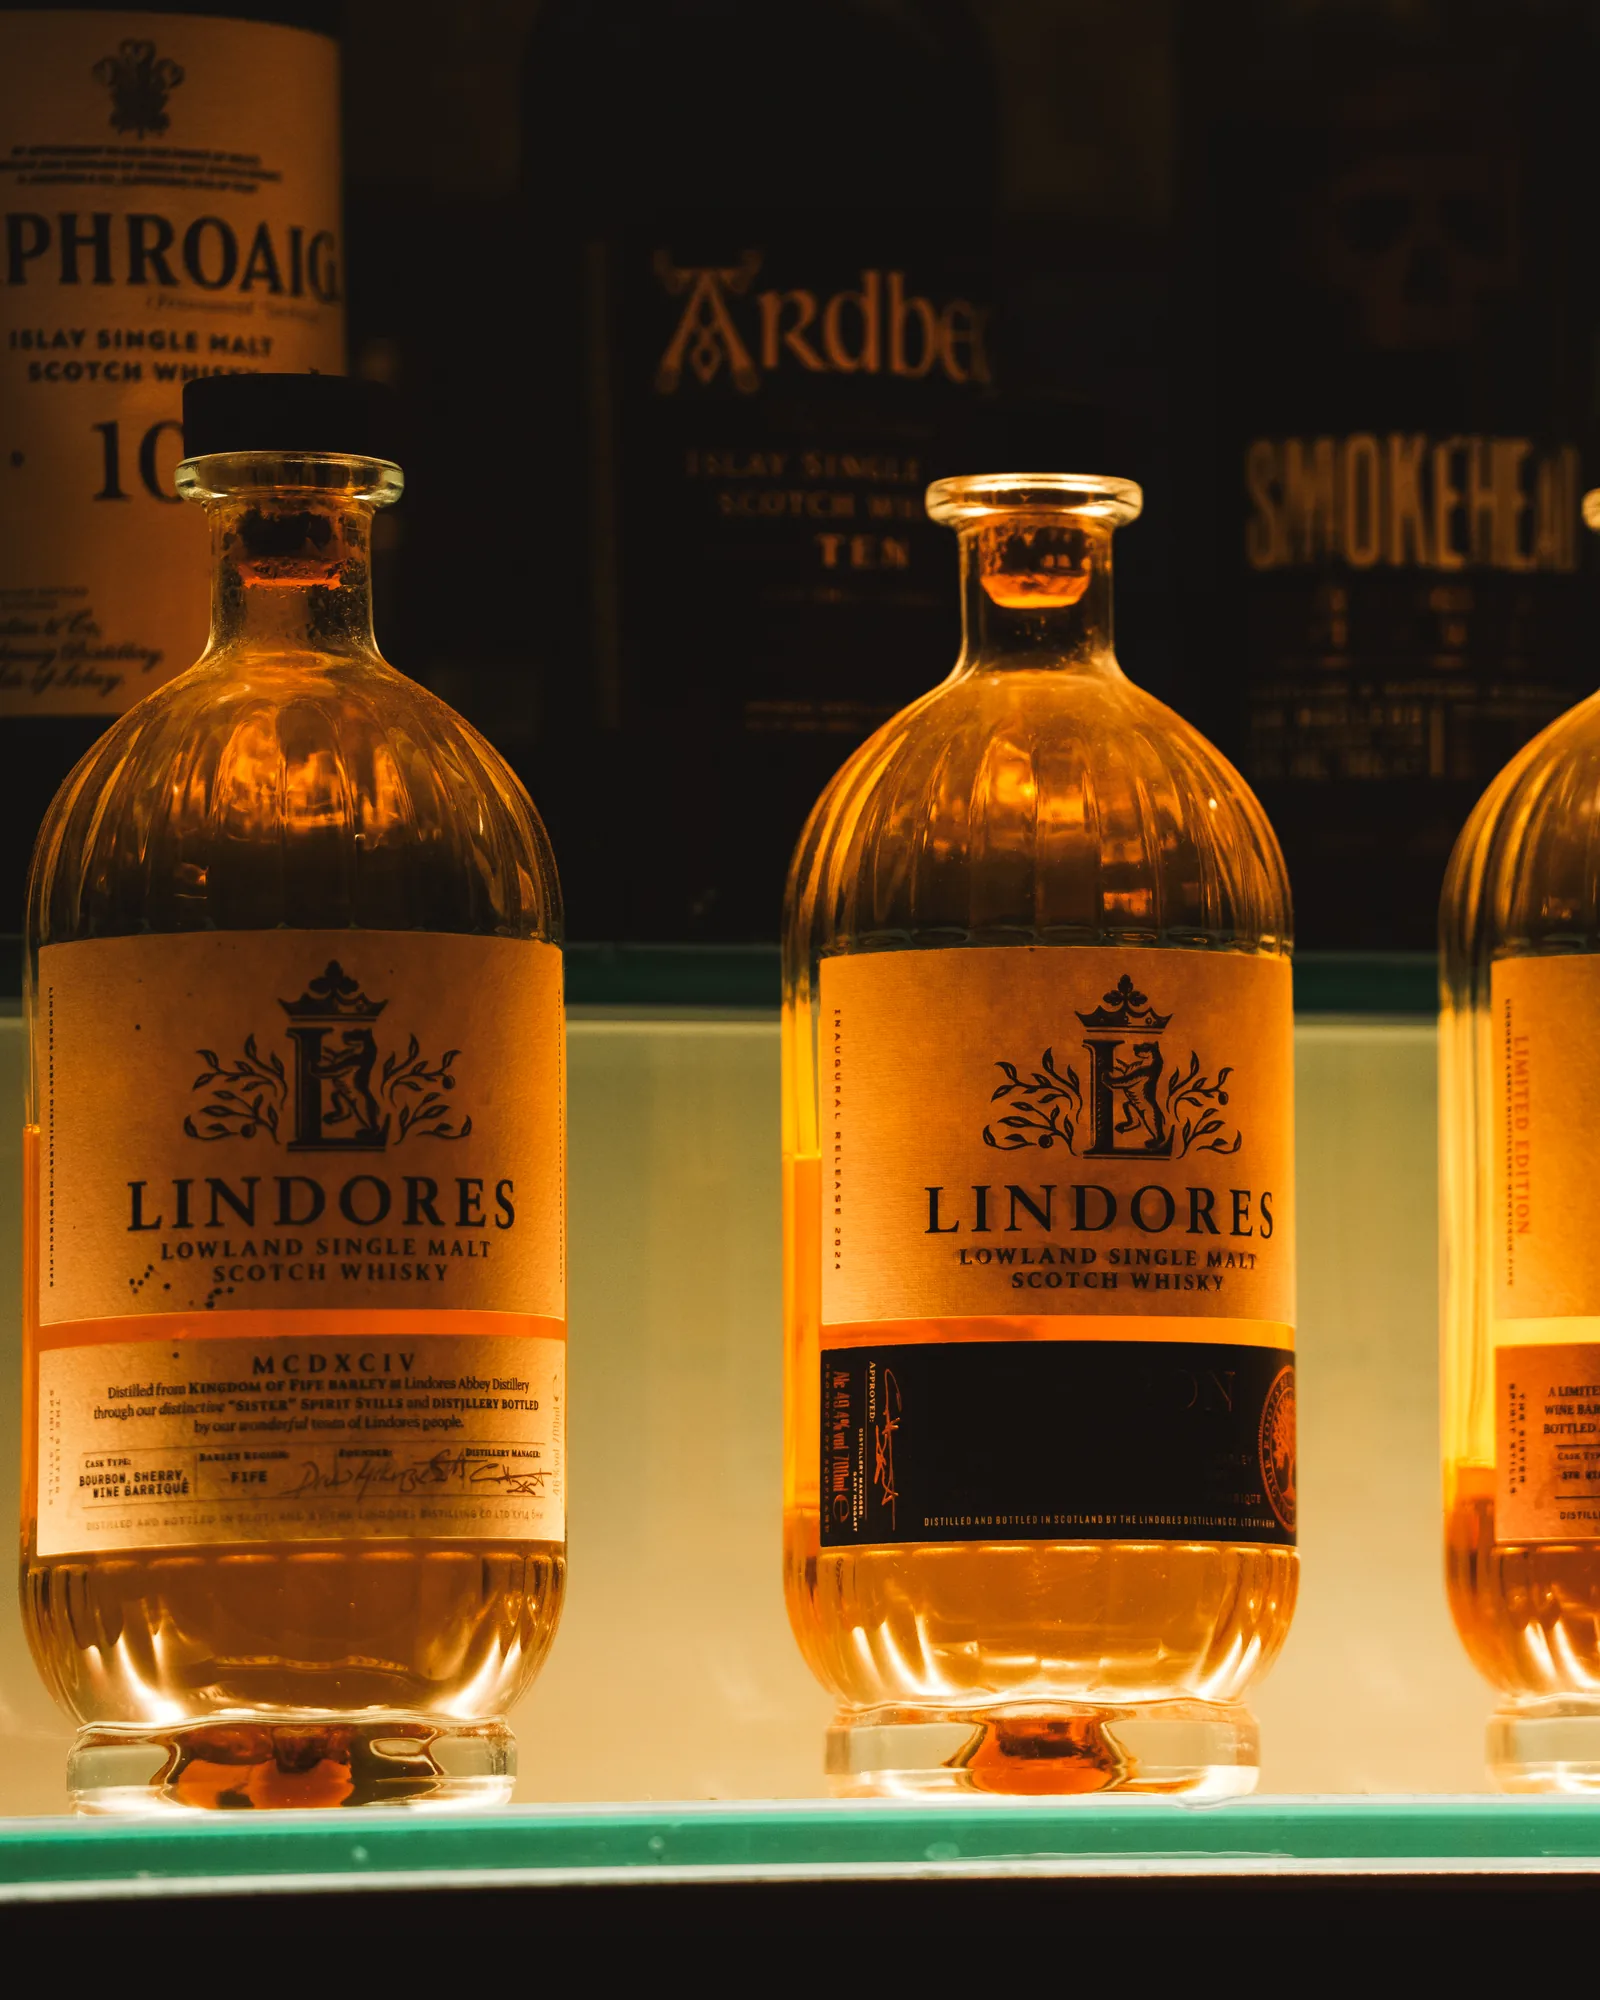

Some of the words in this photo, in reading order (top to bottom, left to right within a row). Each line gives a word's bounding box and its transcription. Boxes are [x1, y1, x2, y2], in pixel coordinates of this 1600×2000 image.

[8, 328, 86, 350] ISLAY
[96, 328, 199, 353] SINGLE
[207, 332, 275, 358] MALT
[27, 360, 144, 384] SCOTCH
[152, 361, 260, 383] WHIS
[91, 419, 185, 505] 10
[814, 532, 911, 570] TEN
[1514, 1036, 1529, 1131] LIMITED
[1515, 1140, 1531, 1235] EDITION
[127, 1174, 516, 1231] LINDORES
[925, 1184, 1274, 1239] LINDORES
[161, 1237, 304, 1261] LOWLAND
[317, 1237, 416, 1257] SINGLE
[428, 1238, 491, 1259] MALT
[959, 1247, 1098, 1266] LOWLAND
[1109, 1248, 1197, 1267] SINGLE
[1206, 1251, 1257, 1270] MALT
[212, 1263, 326, 1284] SCOTCH
[341, 1262, 449, 1282] WHISKY
[1012, 1271, 1118, 1289] SCOTCH
[1131, 1273, 1225, 1292] WHISKY
[252, 1352, 415, 1376] MCDXCIV
[108, 1384, 154, 1399] Distilled
[155, 1382, 186, 1397] from
[188, 1381, 261, 1394] KINGDOM
[289, 1379, 323, 1391] FIFE
[328, 1378, 387, 1390] BARLEY
[404, 1375, 457, 1390] Lindores
[458, 1376, 490, 1392] Abbey
[492, 1377, 530, 1393] Distillery
[833, 1370, 850, 1389] Alc
[1548, 1386, 1556, 1397] A
[868, 1361, 876, 1423] APPROVED:
[93, 1404, 135, 1421] through
[136, 1406, 157, 1416] our
[159, 1401, 225, 1416] distinctive
[355, 1397, 403, 1409] STILLS
[406, 1396, 430, 1409] and
[432, 1398, 498, 1411] DISTILLERY
[501, 1399, 539, 1411] BOTTLED
[1544, 1404, 1574, 1415] WINE
[194, 1418, 210, 1434] by
[213, 1420, 235, 1432] our
[239, 1416, 309, 1433] wonderful
[347, 1415, 361, 1429] of
[365, 1414, 421, 1430] Lindores
[422, 1415, 464, 1431] people.
[1543, 1423, 1596, 1434] BOTTLED
[231, 1470, 268, 1484] FIFE
[833, 1454, 850, 1492] 700ml
[92, 1485, 119, 1499] WINE
[924, 1516, 971, 1527] DISTILLED
[974, 1515, 993, 1525] AND
[996, 1515, 1038, 1525] BOTTLED
[1041, 1515, 1051, 1524] IN
[1054, 1514, 1103, 1524] SCOTLAND
[1106, 1515, 1117, 1524] BY
[1120, 1515, 1136, 1524] THE
[1139, 1515, 1182, 1525] LINDORES
[1183, 1516, 1227, 1526] DISTILLING
[1560, 1511, 1600, 1520] DISTILL
